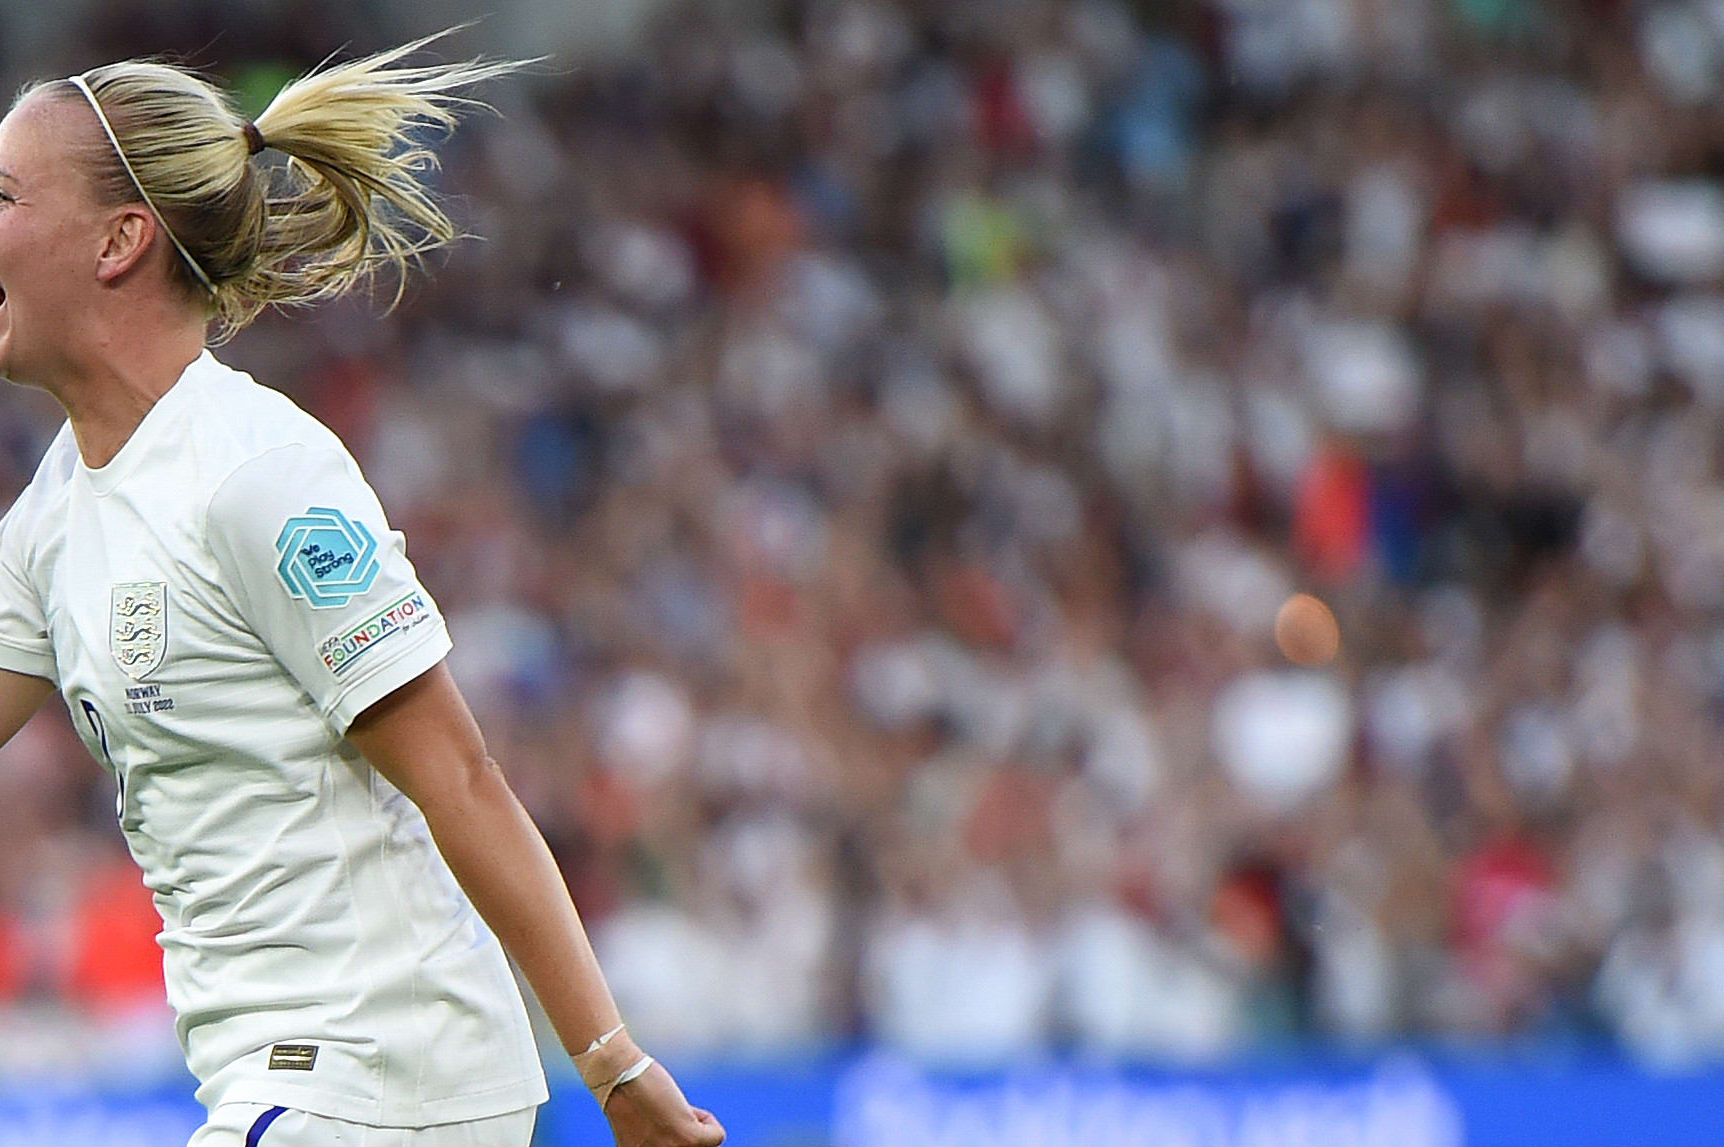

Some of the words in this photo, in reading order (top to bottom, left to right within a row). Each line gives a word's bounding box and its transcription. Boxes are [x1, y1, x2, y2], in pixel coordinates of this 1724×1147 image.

[300, 543, 320, 556] We
[323, 595, 425, 670] FOUNDATION
[125, 684, 162, 700] NORWAY
